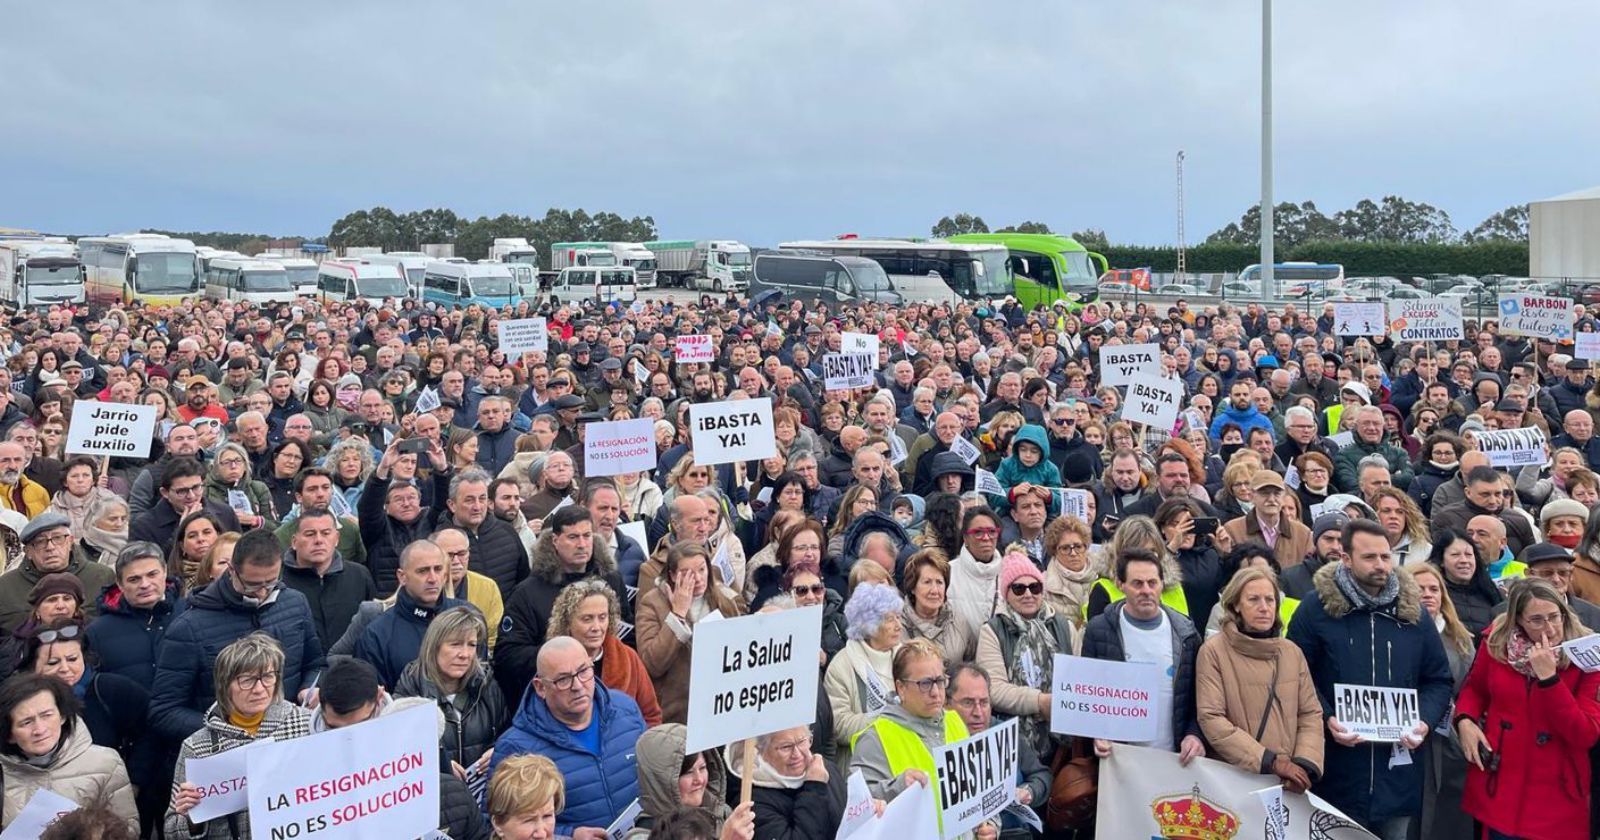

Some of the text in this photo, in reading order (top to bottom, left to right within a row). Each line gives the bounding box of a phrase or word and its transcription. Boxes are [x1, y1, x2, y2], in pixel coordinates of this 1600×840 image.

[1402, 310, 1439, 319] EXCUSAS
[1400, 327, 1460, 340] CONTRATOS
[824, 353, 873, 380] ¡BASTA YA!
[1106, 353, 1153, 365] ¡BASTA
[1132, 383, 1174, 405] ¡BASTA
[91, 407, 139, 422] Jarrio
[1141, 401, 1160, 416] YA!
[94, 423, 130, 437] pide
[698, 412, 763, 432] ¡BASTA
[82, 438, 137, 452] auxilio
[588, 441, 597, 449] LA
[718, 432, 747, 449] YA!
[589, 452, 600, 460] NO
[600, 451, 609, 460] ES
[722, 634, 793, 674] La Salud
[1060, 682, 1073, 693] LA
[713, 678, 794, 715] no espera
[1060, 700, 1076, 710] NO
[1079, 702, 1090, 712] ES
[1337, 688, 1417, 727] ¡BASTA YA!
[937, 737, 994, 811] ¡BASTA
[995, 723, 1016, 782] YA!
[196, 775, 248, 799] BASTA
[267, 794, 290, 811] LA
[295, 752, 424, 805] RESIGNACIÓN
[271, 781, 424, 840] NO ES SOLUCIÓN
